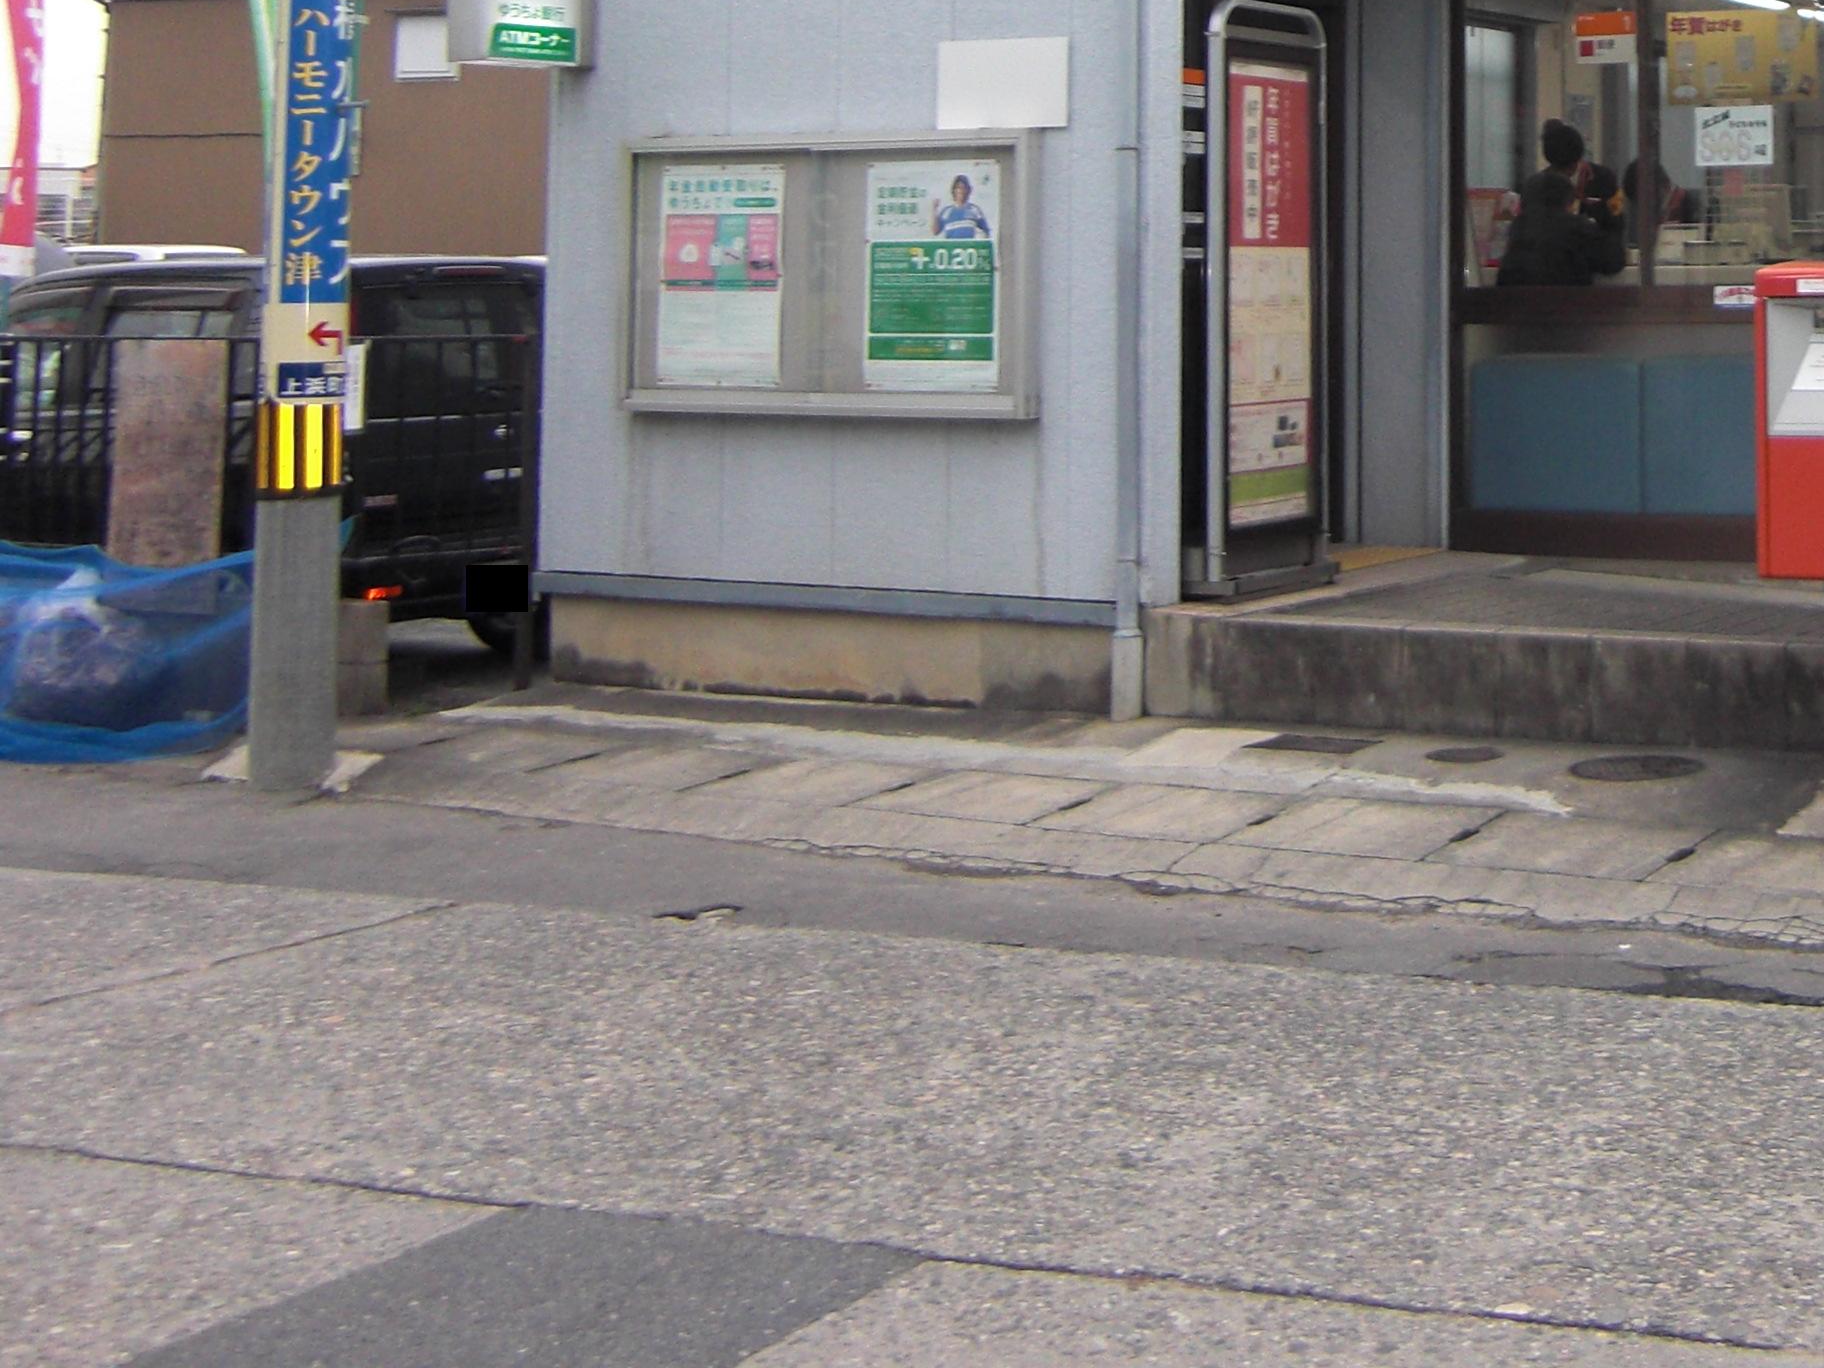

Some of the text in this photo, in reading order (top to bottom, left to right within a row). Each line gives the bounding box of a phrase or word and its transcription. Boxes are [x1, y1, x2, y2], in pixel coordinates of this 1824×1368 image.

[499, 2, 566, 21] ゆうちょ銀行
[1670, 16, 1743, 36] 年賀はがき
[499, 29, 571, 47] ATMコーナー
[285, 8, 330, 285] ハーモニータウン津
